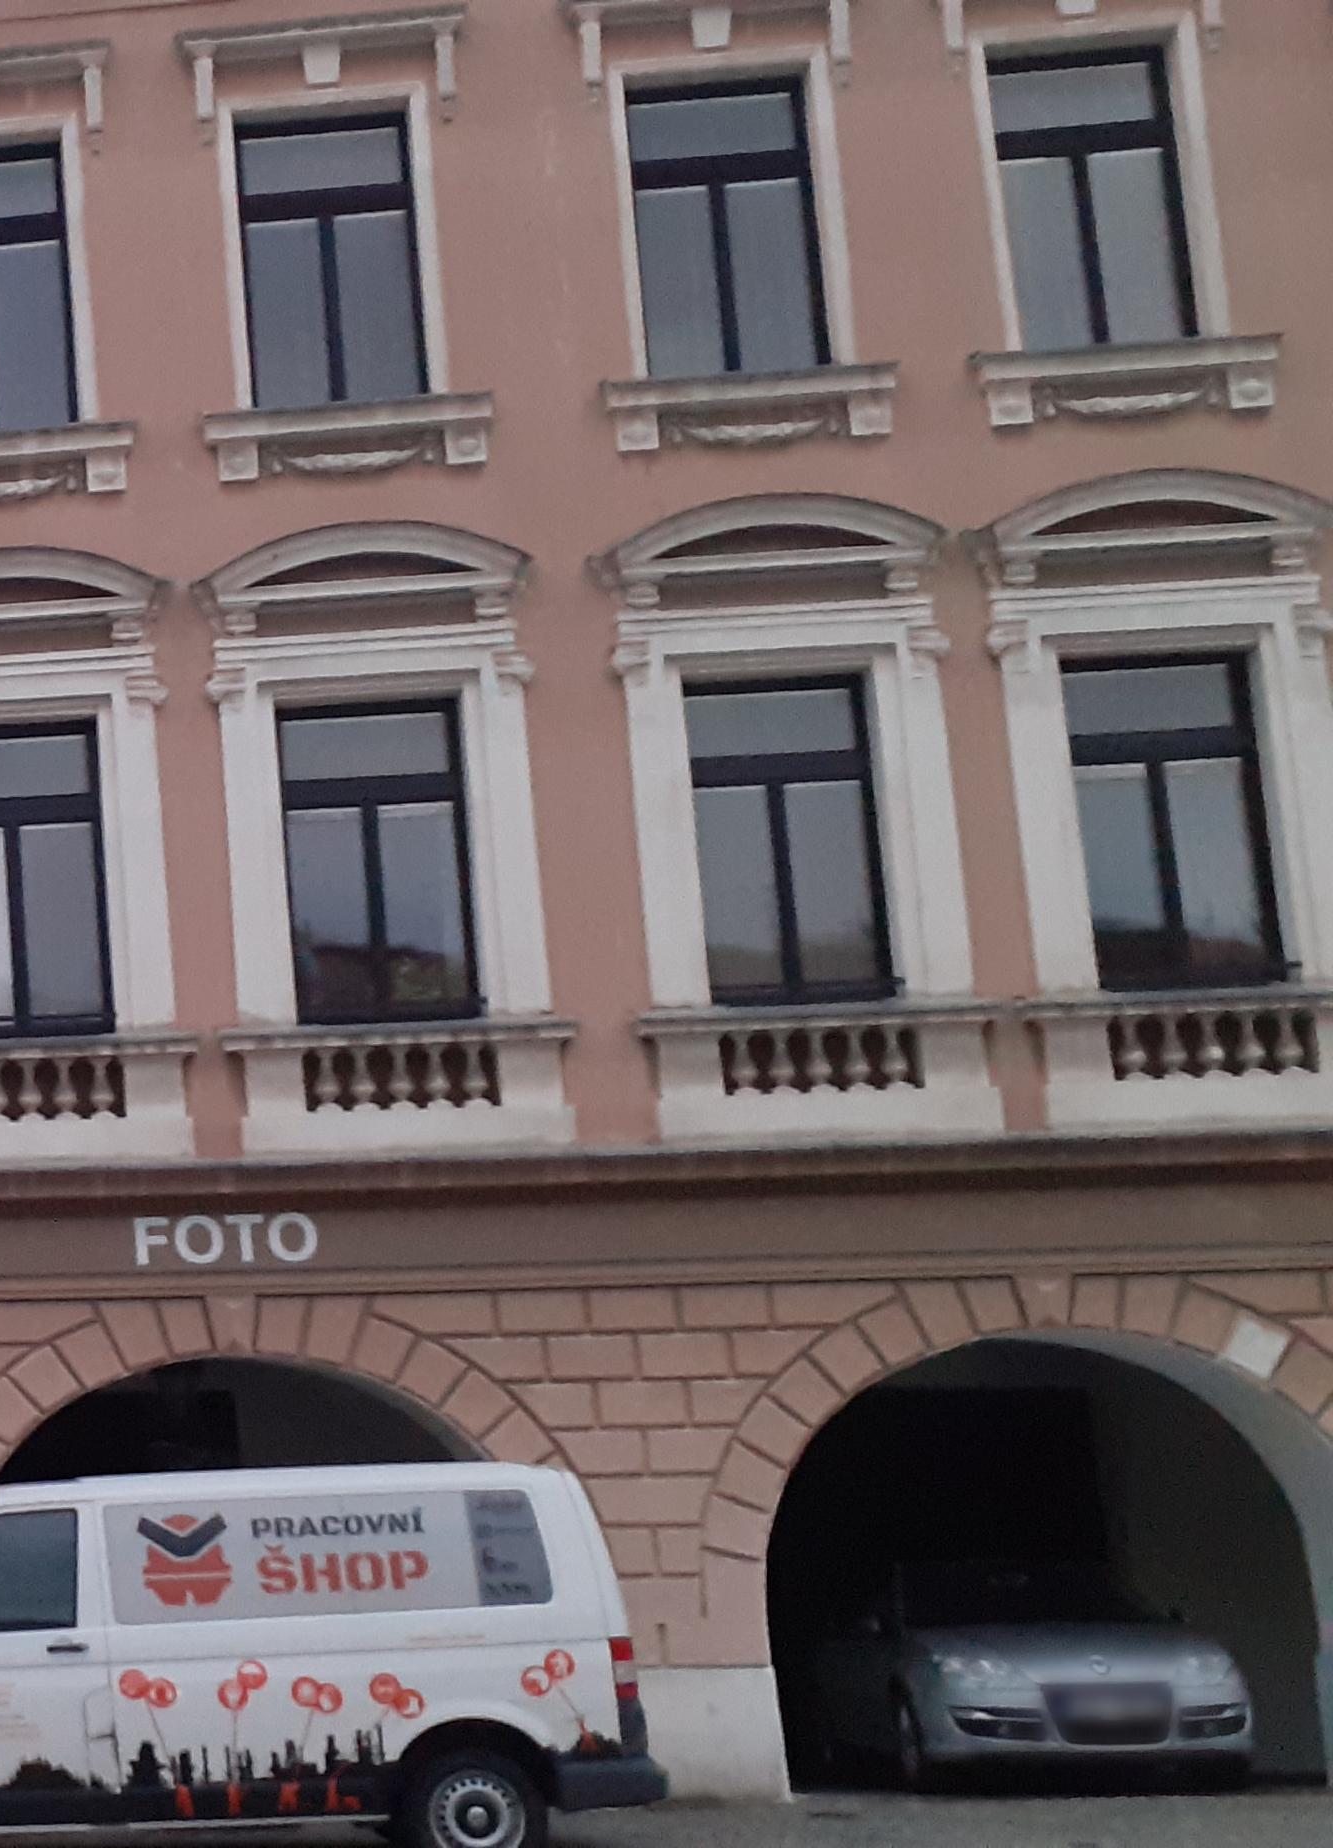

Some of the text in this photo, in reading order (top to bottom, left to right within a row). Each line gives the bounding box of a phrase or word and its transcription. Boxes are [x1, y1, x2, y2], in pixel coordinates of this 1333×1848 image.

[133, 1211, 318, 1266] FOTO
[251, 1506, 424, 1538] PRACOVNÍ
[256, 1544, 429, 1594] ŠHOP
